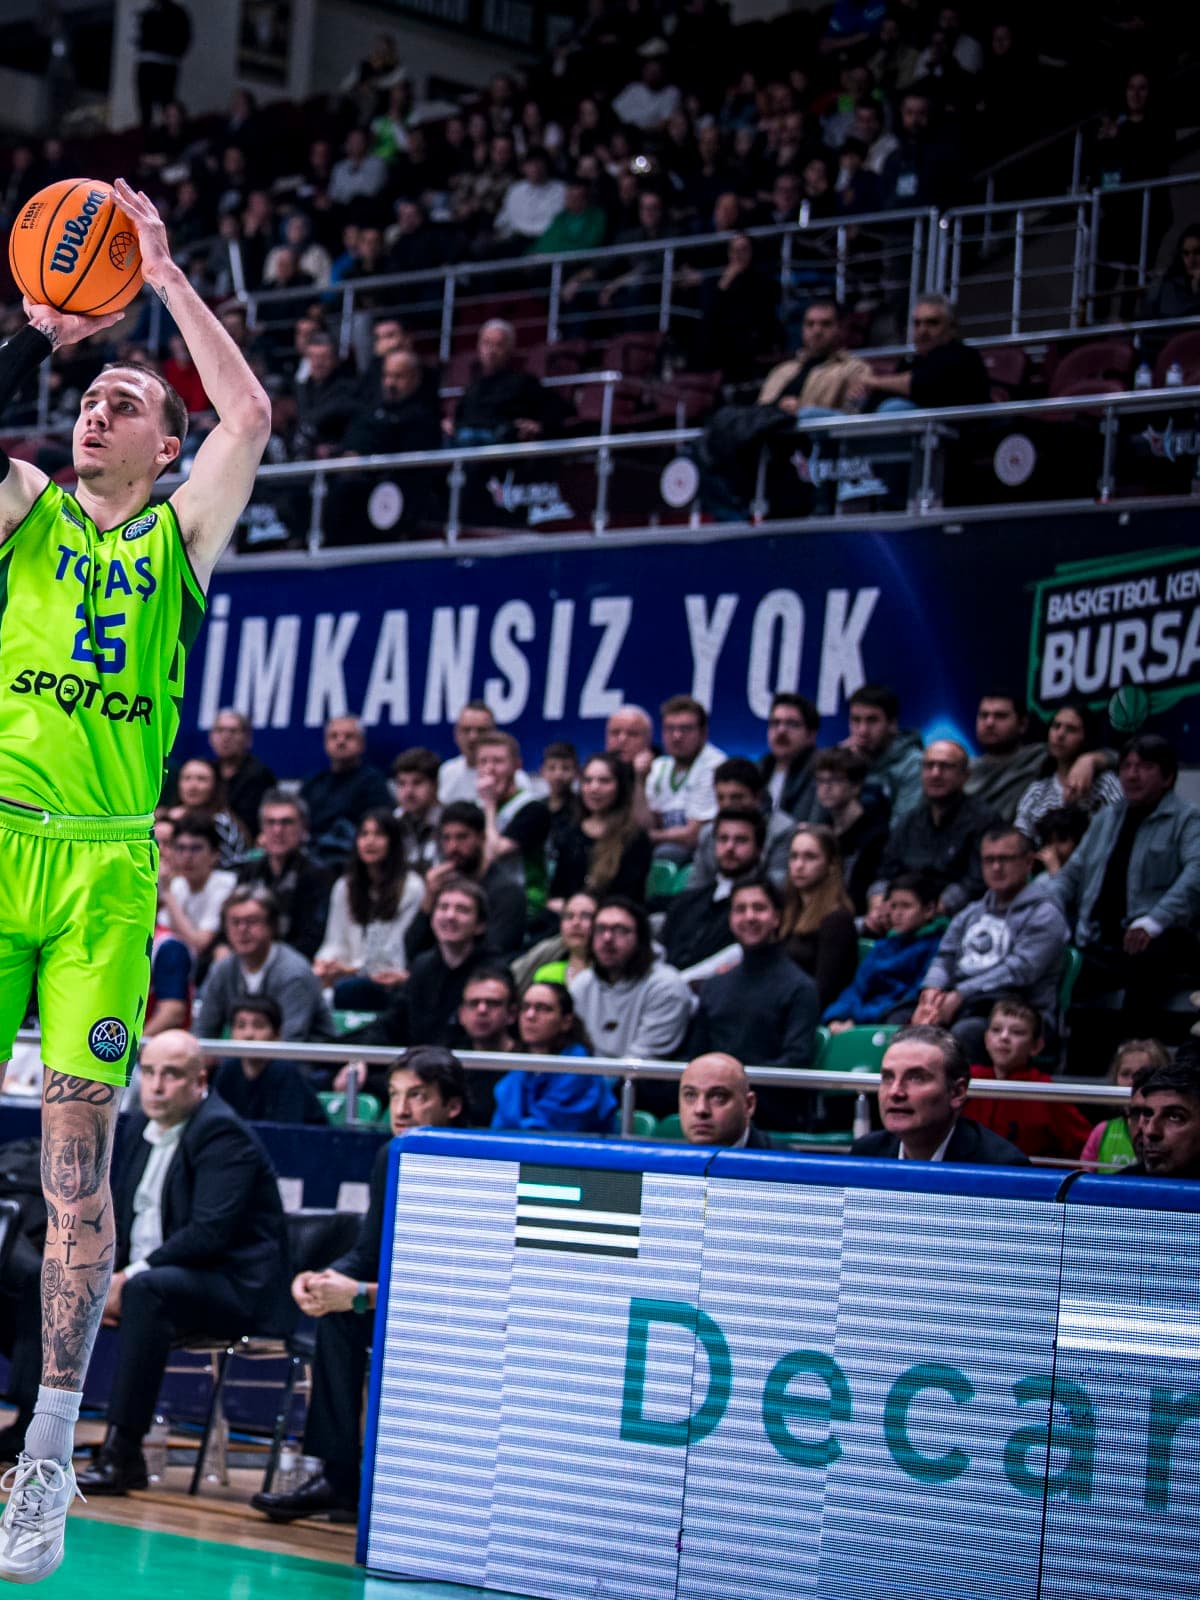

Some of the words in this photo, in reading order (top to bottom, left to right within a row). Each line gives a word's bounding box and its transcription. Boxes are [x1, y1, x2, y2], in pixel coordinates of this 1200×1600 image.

[49, 189, 107, 275] Wilson
[55, 544, 157, 603] TOAŞ
[1046, 576, 1162, 625] BASKETBOL
[70, 602, 127, 675] 25
[197, 592, 634, 732] İMKANSIZ
[684, 586, 882, 721] YOK
[10, 669, 153, 726] SPOTCAR
